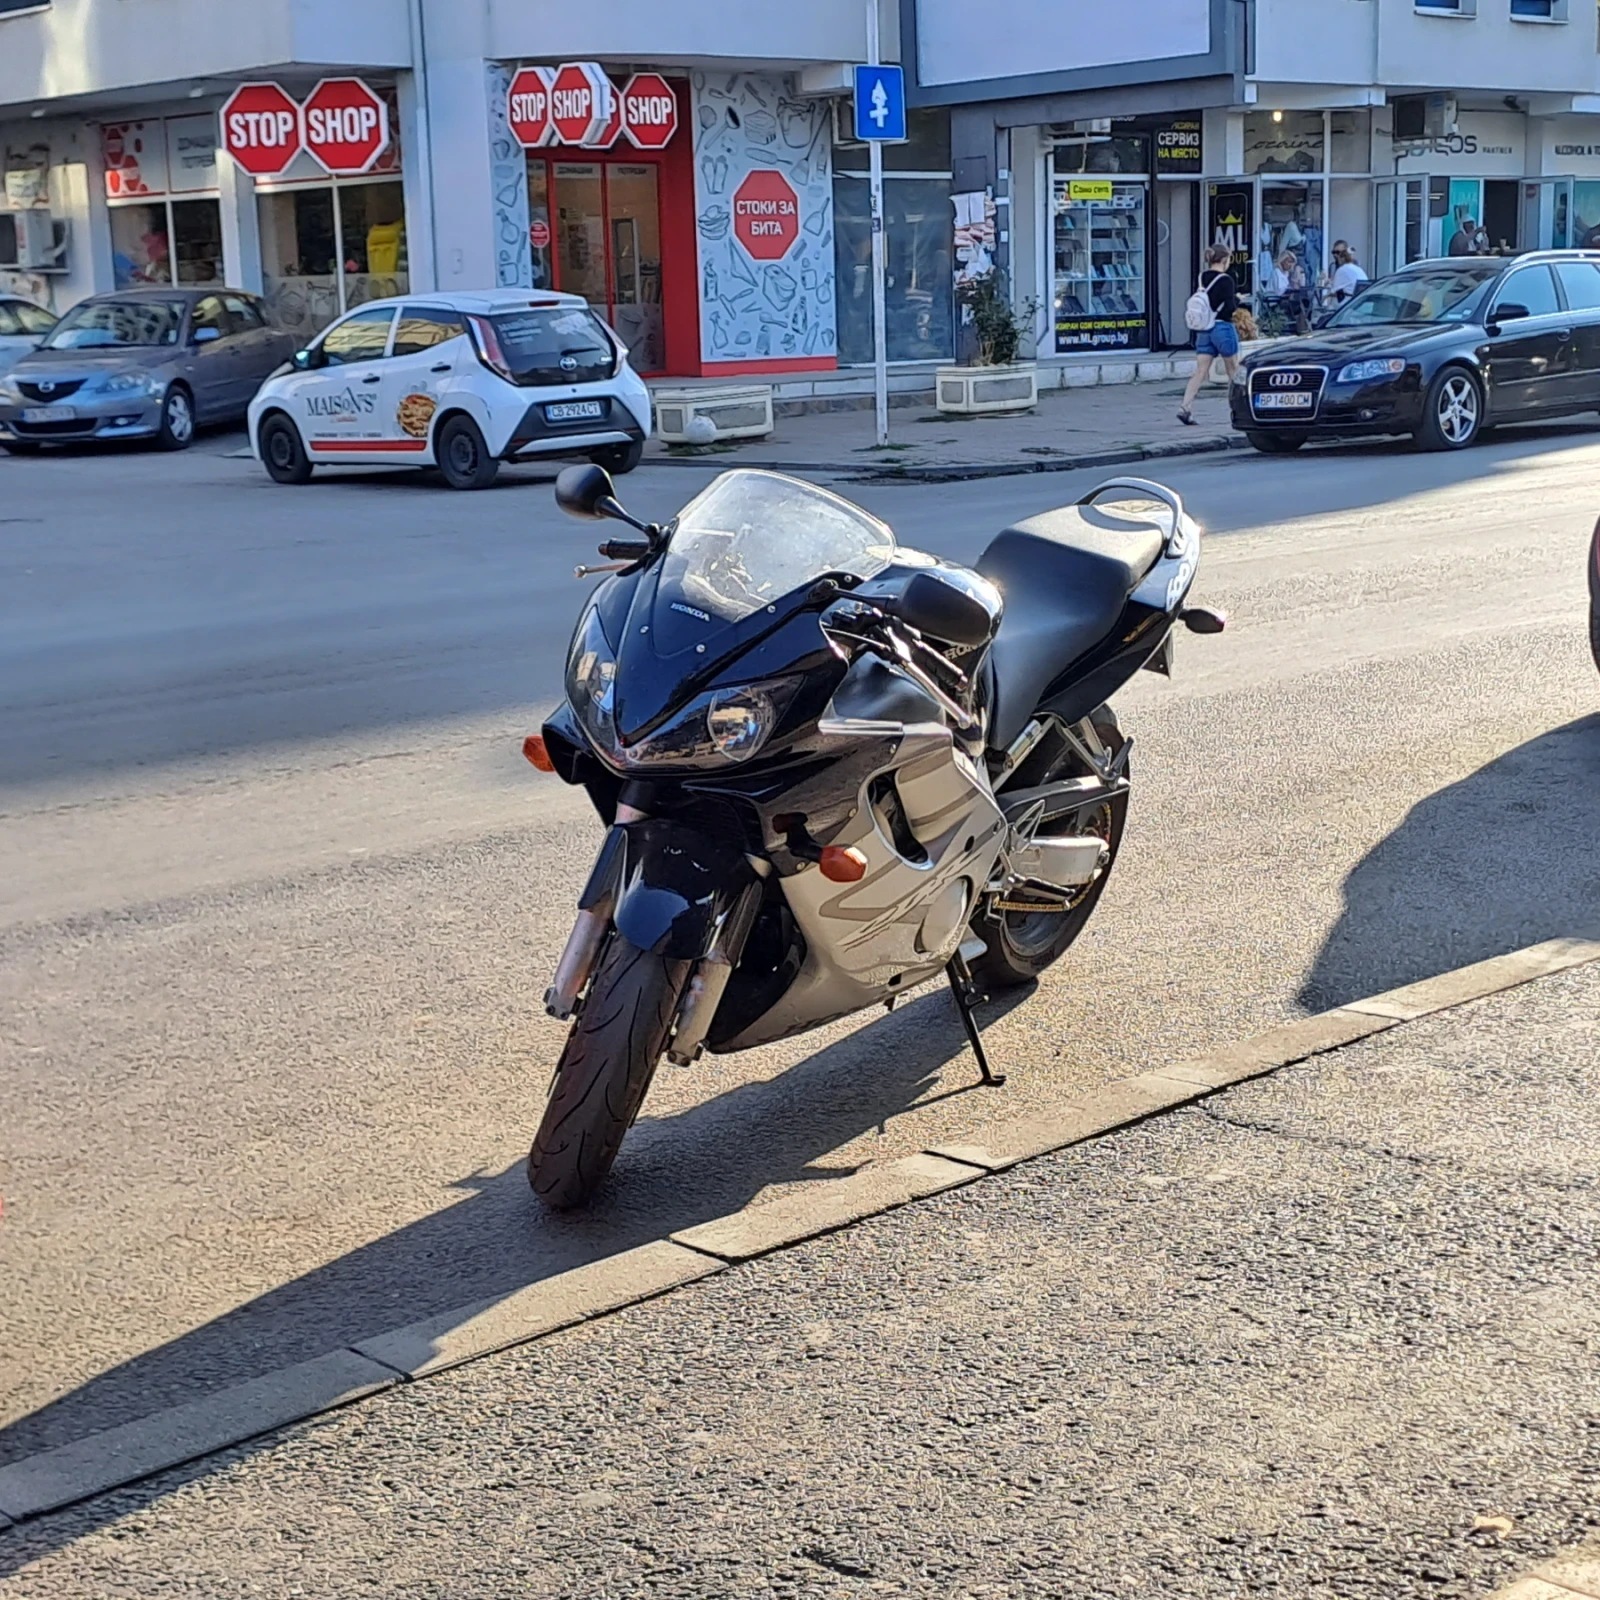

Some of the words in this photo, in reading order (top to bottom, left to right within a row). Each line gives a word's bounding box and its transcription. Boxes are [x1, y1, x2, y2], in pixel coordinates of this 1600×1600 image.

[511, 92, 546, 123] STOP
[553, 88, 591, 120] SHOP
[627, 96, 673, 125] SHOP
[229, 111, 294, 149] STOP
[308, 106, 377, 144] SHOP
[1158, 131, 1200, 146] СЕРВИЗ
[1158, 148, 1170, 158] НА
[736, 200, 777, 215] СТОКИ
[779, 200, 795, 215] ЗА
[751, 220, 783, 235] БИТА
[1214, 224, 1248, 251] ML
[670, 602, 710, 621] HONDA
